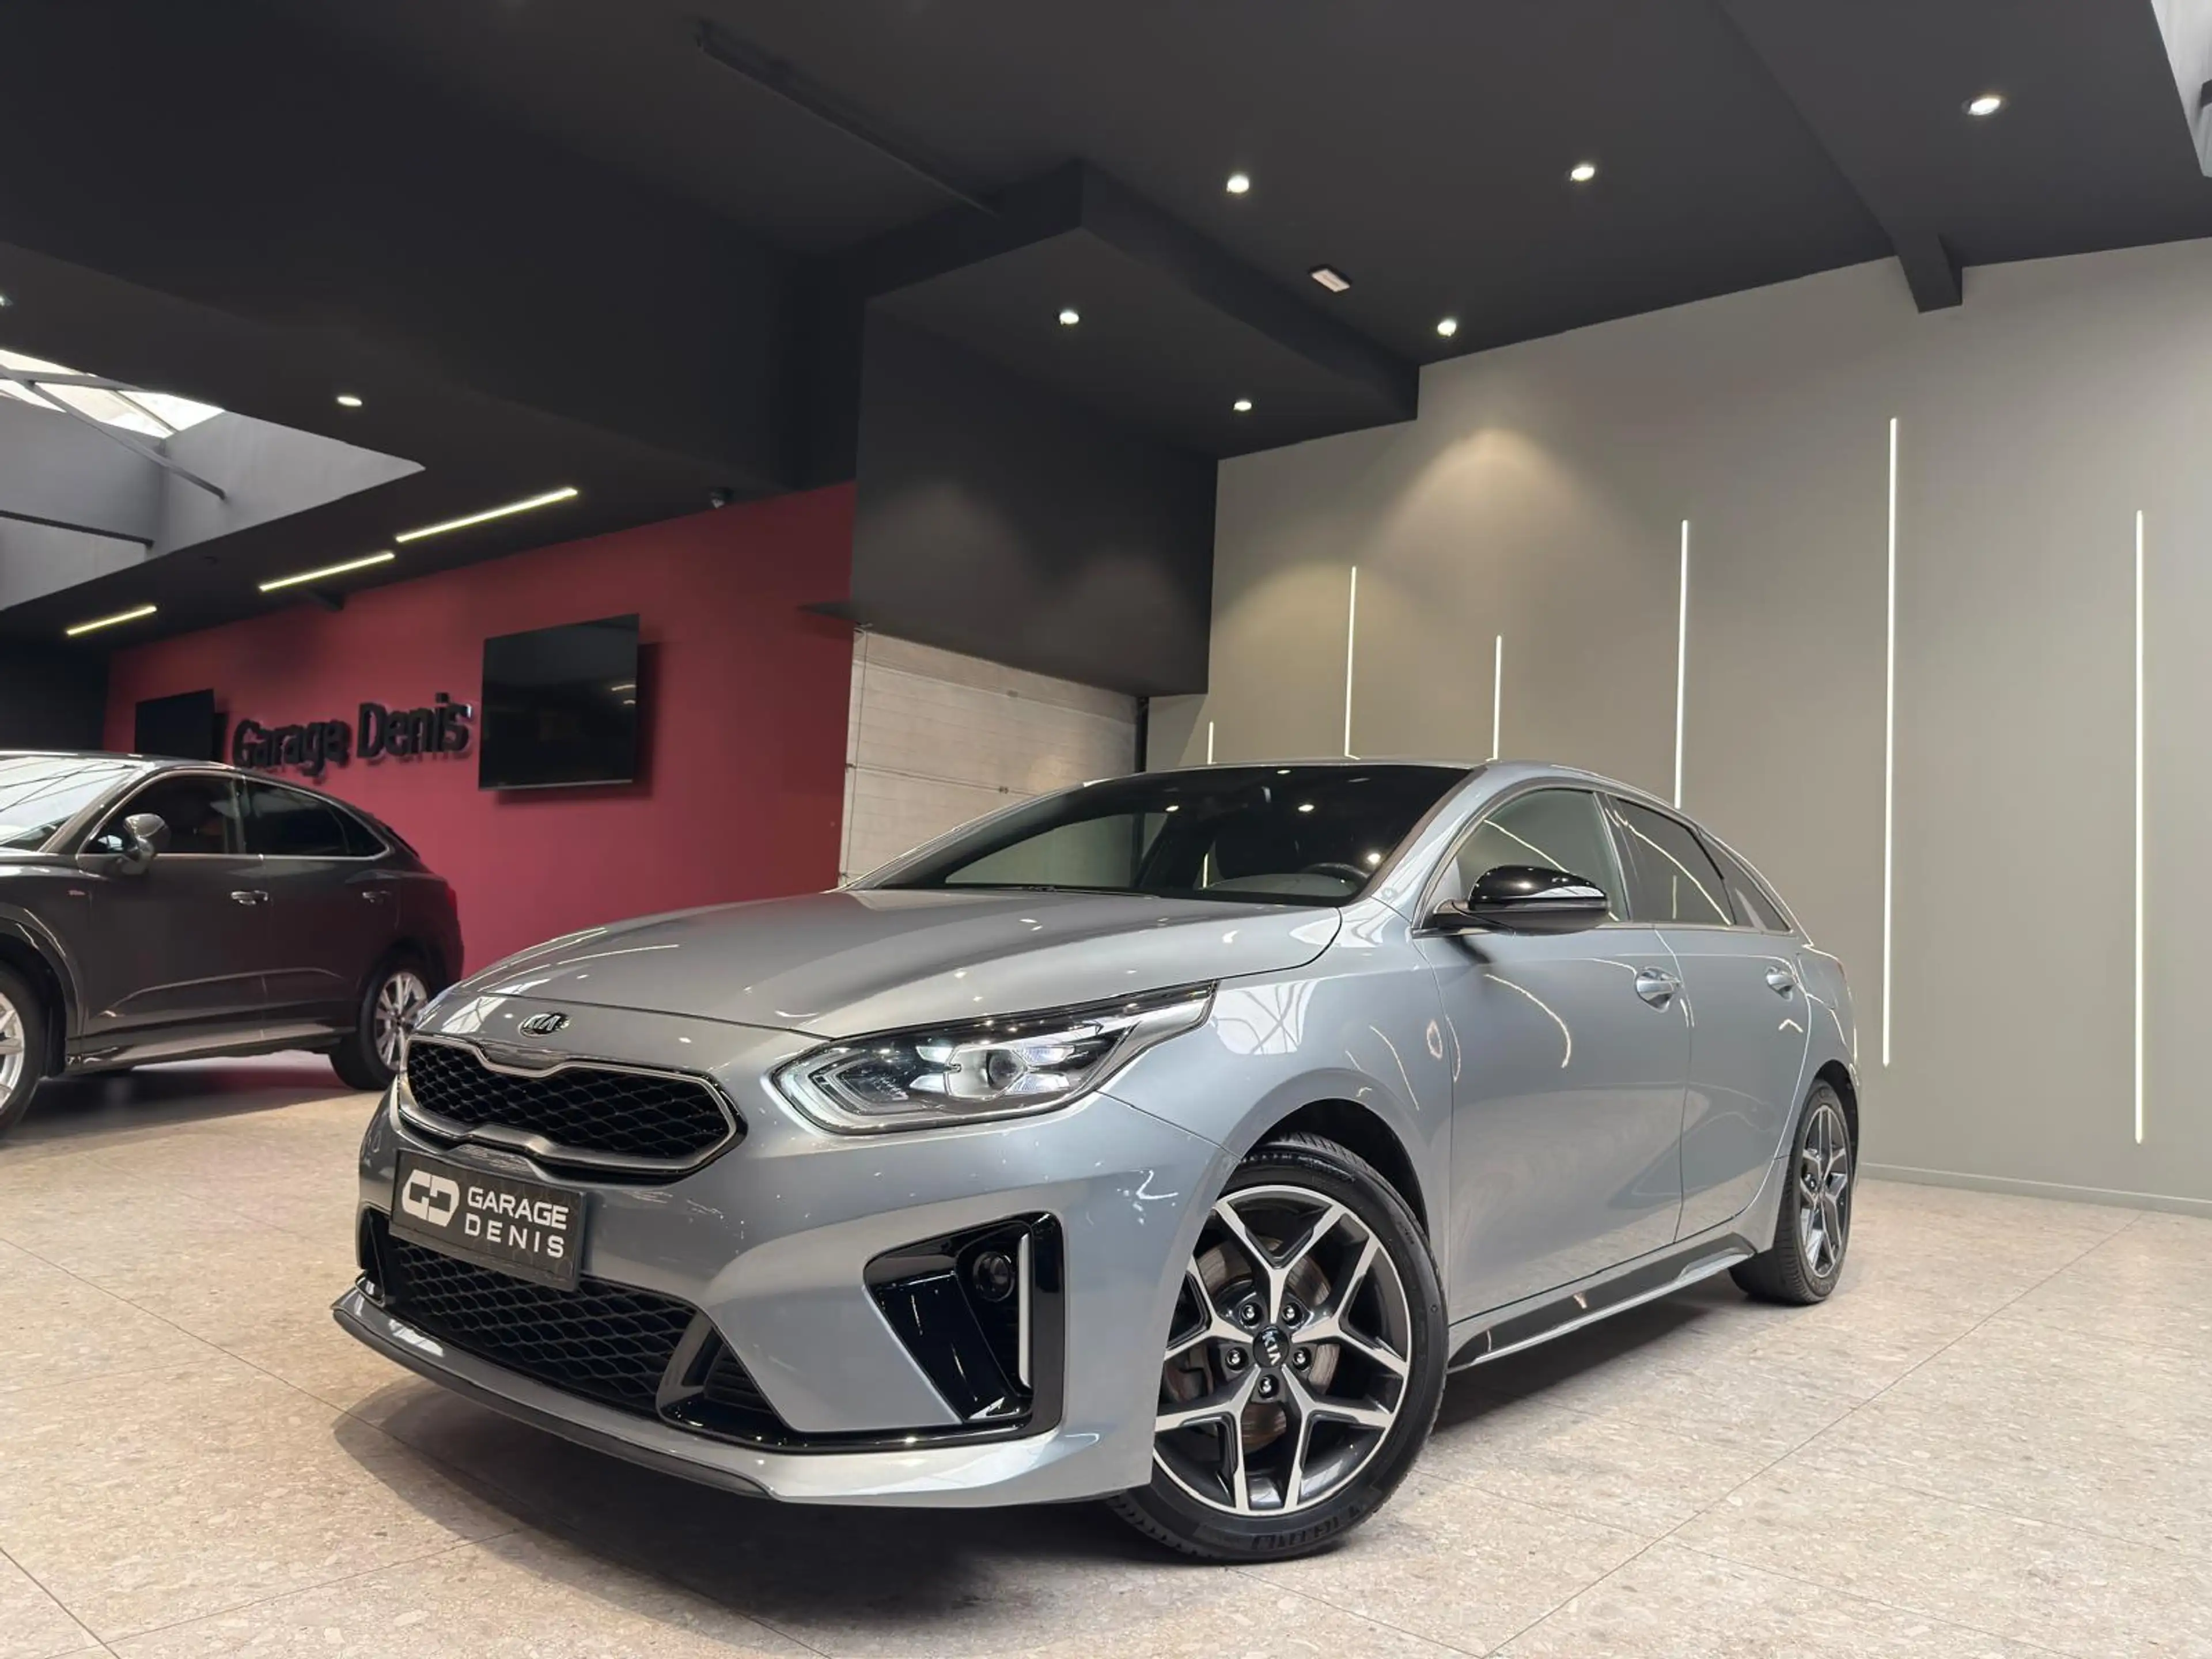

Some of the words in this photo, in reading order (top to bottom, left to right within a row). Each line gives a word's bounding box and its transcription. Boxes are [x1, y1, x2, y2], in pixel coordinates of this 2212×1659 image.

[232, 718, 351, 778] Garage
[357, 692, 473, 759] Denis
[467, 1186, 569, 1230] GARAGE
[464, 1213, 565, 1258] DENIS
[1262, 1330, 1281, 1366] KIA
